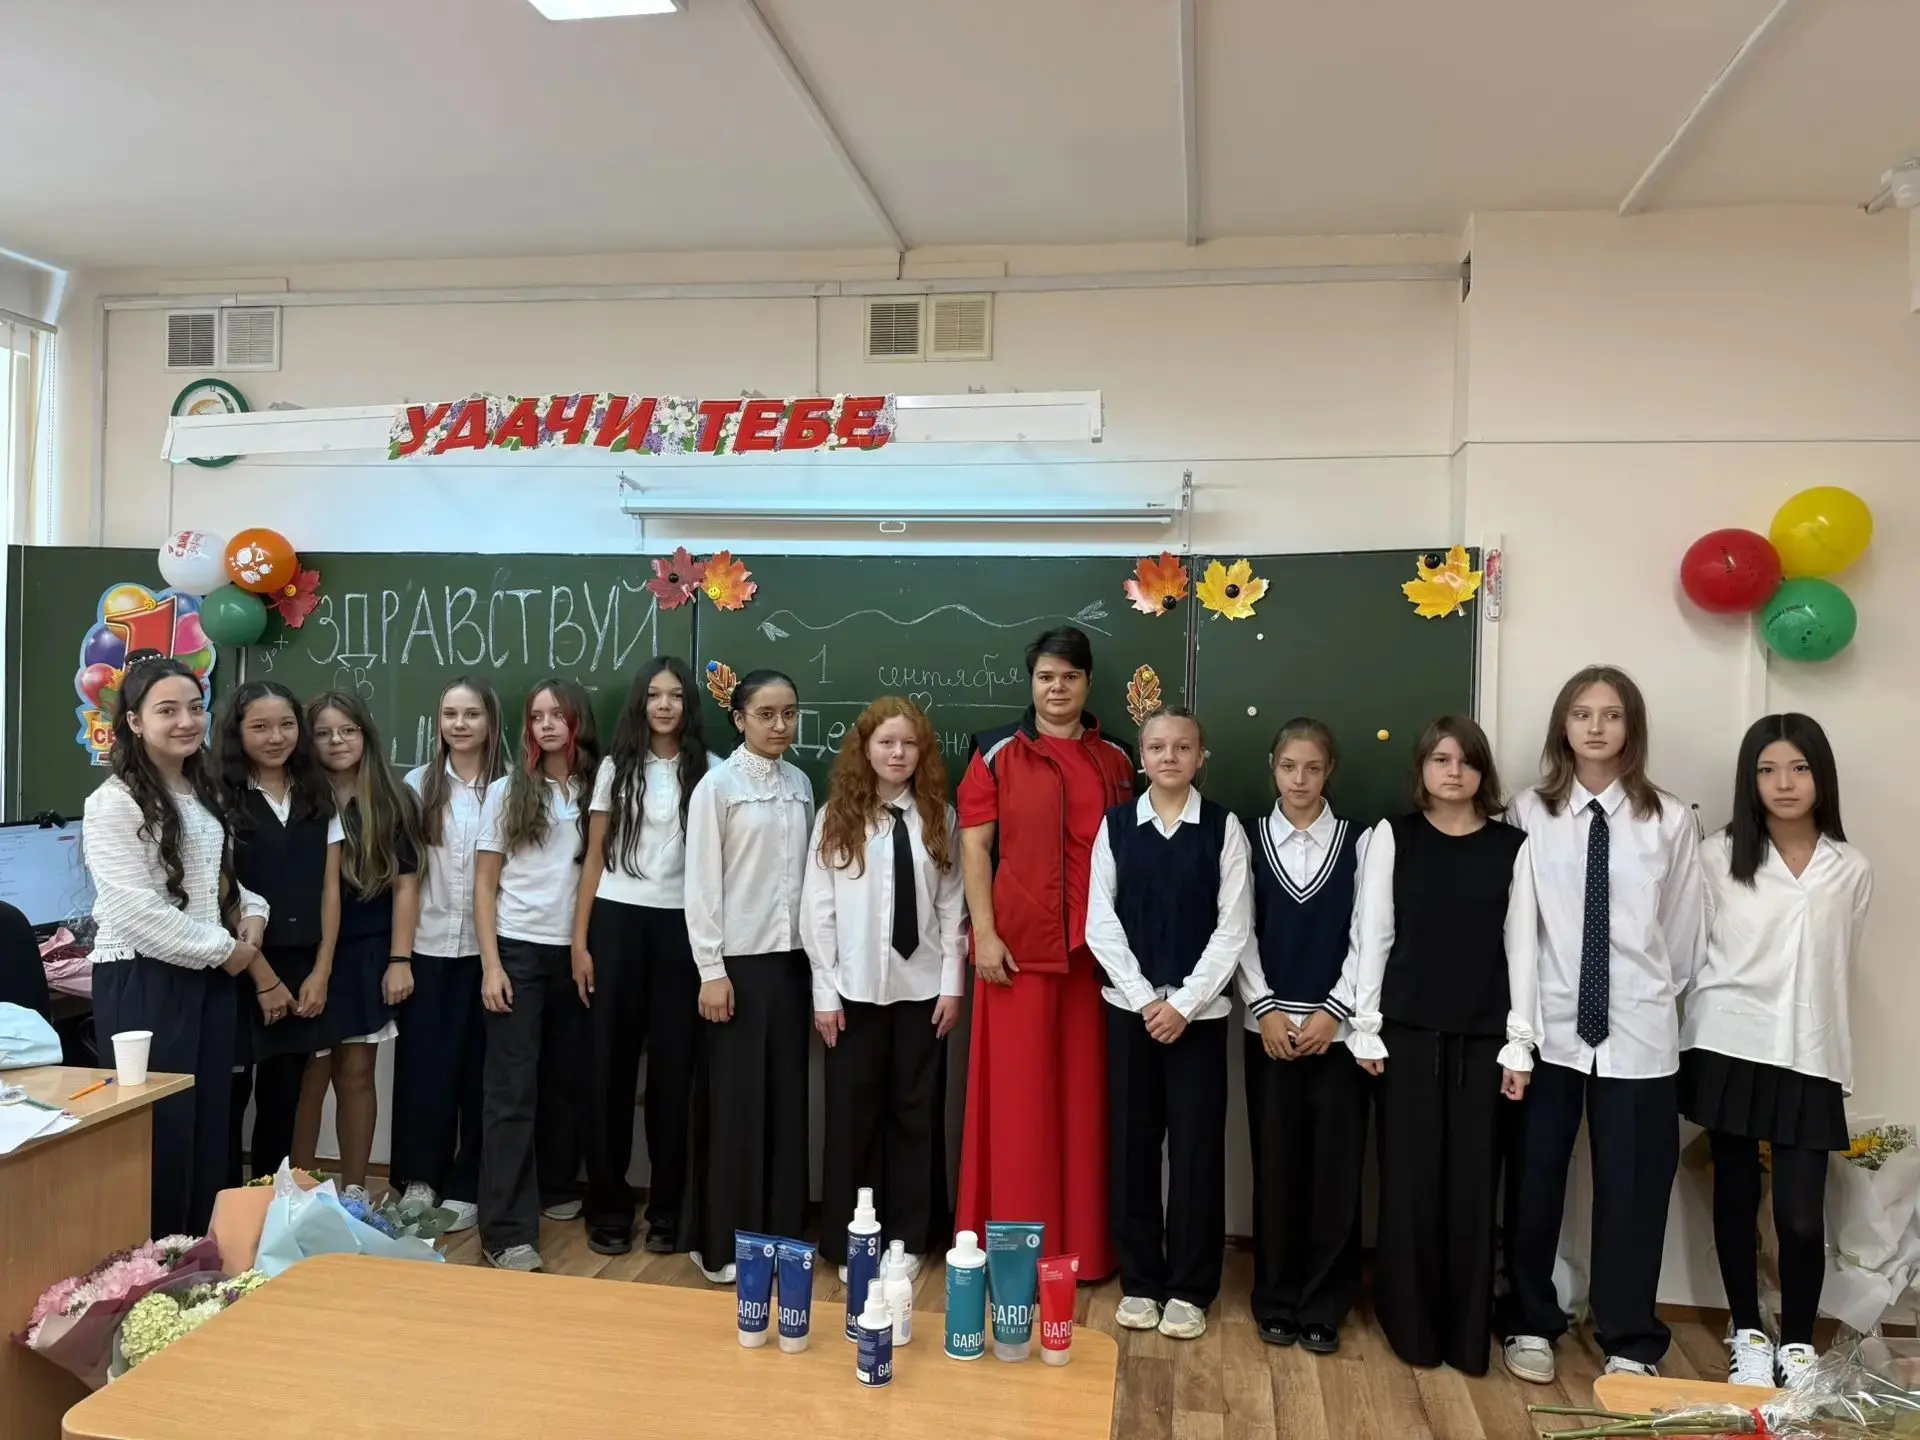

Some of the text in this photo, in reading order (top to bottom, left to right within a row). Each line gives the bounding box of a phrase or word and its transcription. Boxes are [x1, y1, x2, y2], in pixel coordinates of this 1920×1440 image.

[396, 393, 890, 456] УДАЧИ ТЕБЕ
[306, 579, 660, 672] ЗДРАВСТВУЙ
[809, 644, 1025, 698] 1 сентября
[790, 709, 970, 760] Де ЗНА
[738, 1299, 769, 1320] ARDA
[779, 1305, 808, 1327] ARDA
[997, 1325, 1029, 1335] PREMIUM
[1043, 1319, 1073, 1338] GARD
[878, 1361, 893, 1377] GAR
